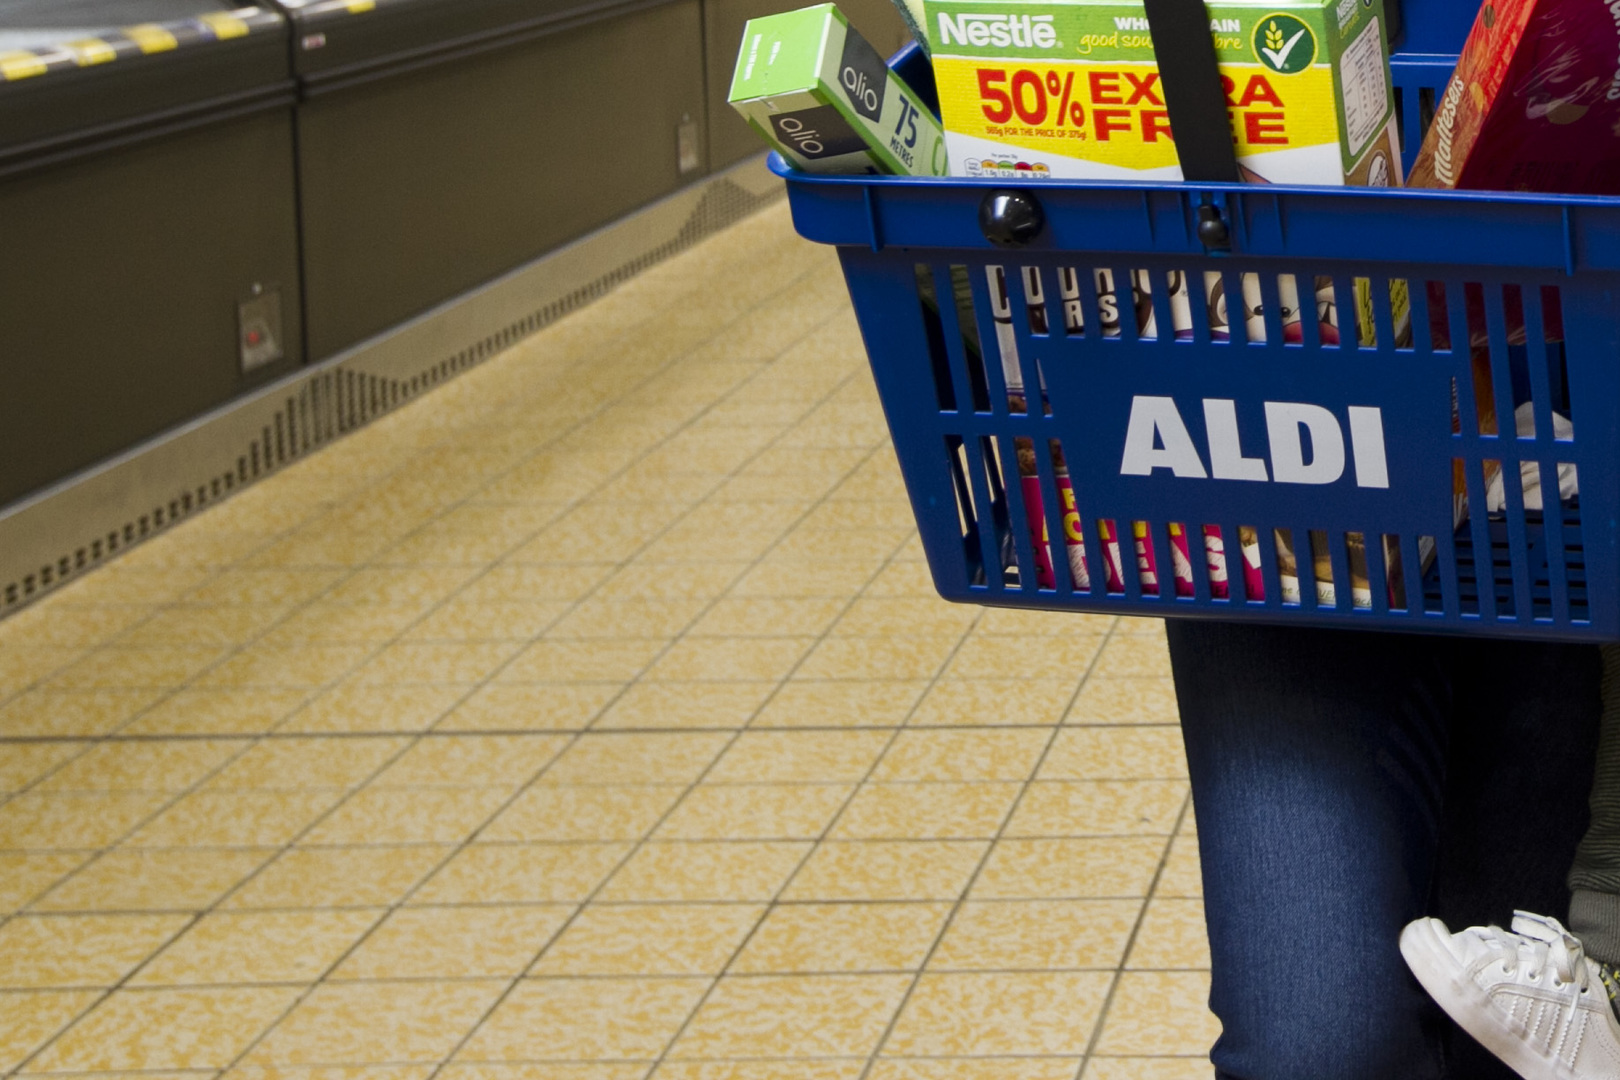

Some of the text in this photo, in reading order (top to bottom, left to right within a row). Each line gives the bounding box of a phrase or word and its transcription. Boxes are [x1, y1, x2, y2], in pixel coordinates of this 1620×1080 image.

[936, 11, 1058, 49] Nestlé
[1076, 31, 1243, 55] good sou bre
[1210, 18, 1241, 33] AIN
[843, 66, 878, 112] alio
[976, 69, 1286, 128] 50% EXRA
[778, 117, 824, 155] alio
[894, 93, 920, 149] 75
[1004, 127, 1019, 136] FOR
[1019, 128, 1034, 137] THE
[1035, 128, 1056, 138] PRICE
[1056, 129, 1068, 138] OF
[1093, 109, 1290, 146] FRE
[1433, 74, 1465, 187] Maltesers
[889, 136, 914, 169] METRES
[1119, 395, 1390, 489] ALDI
